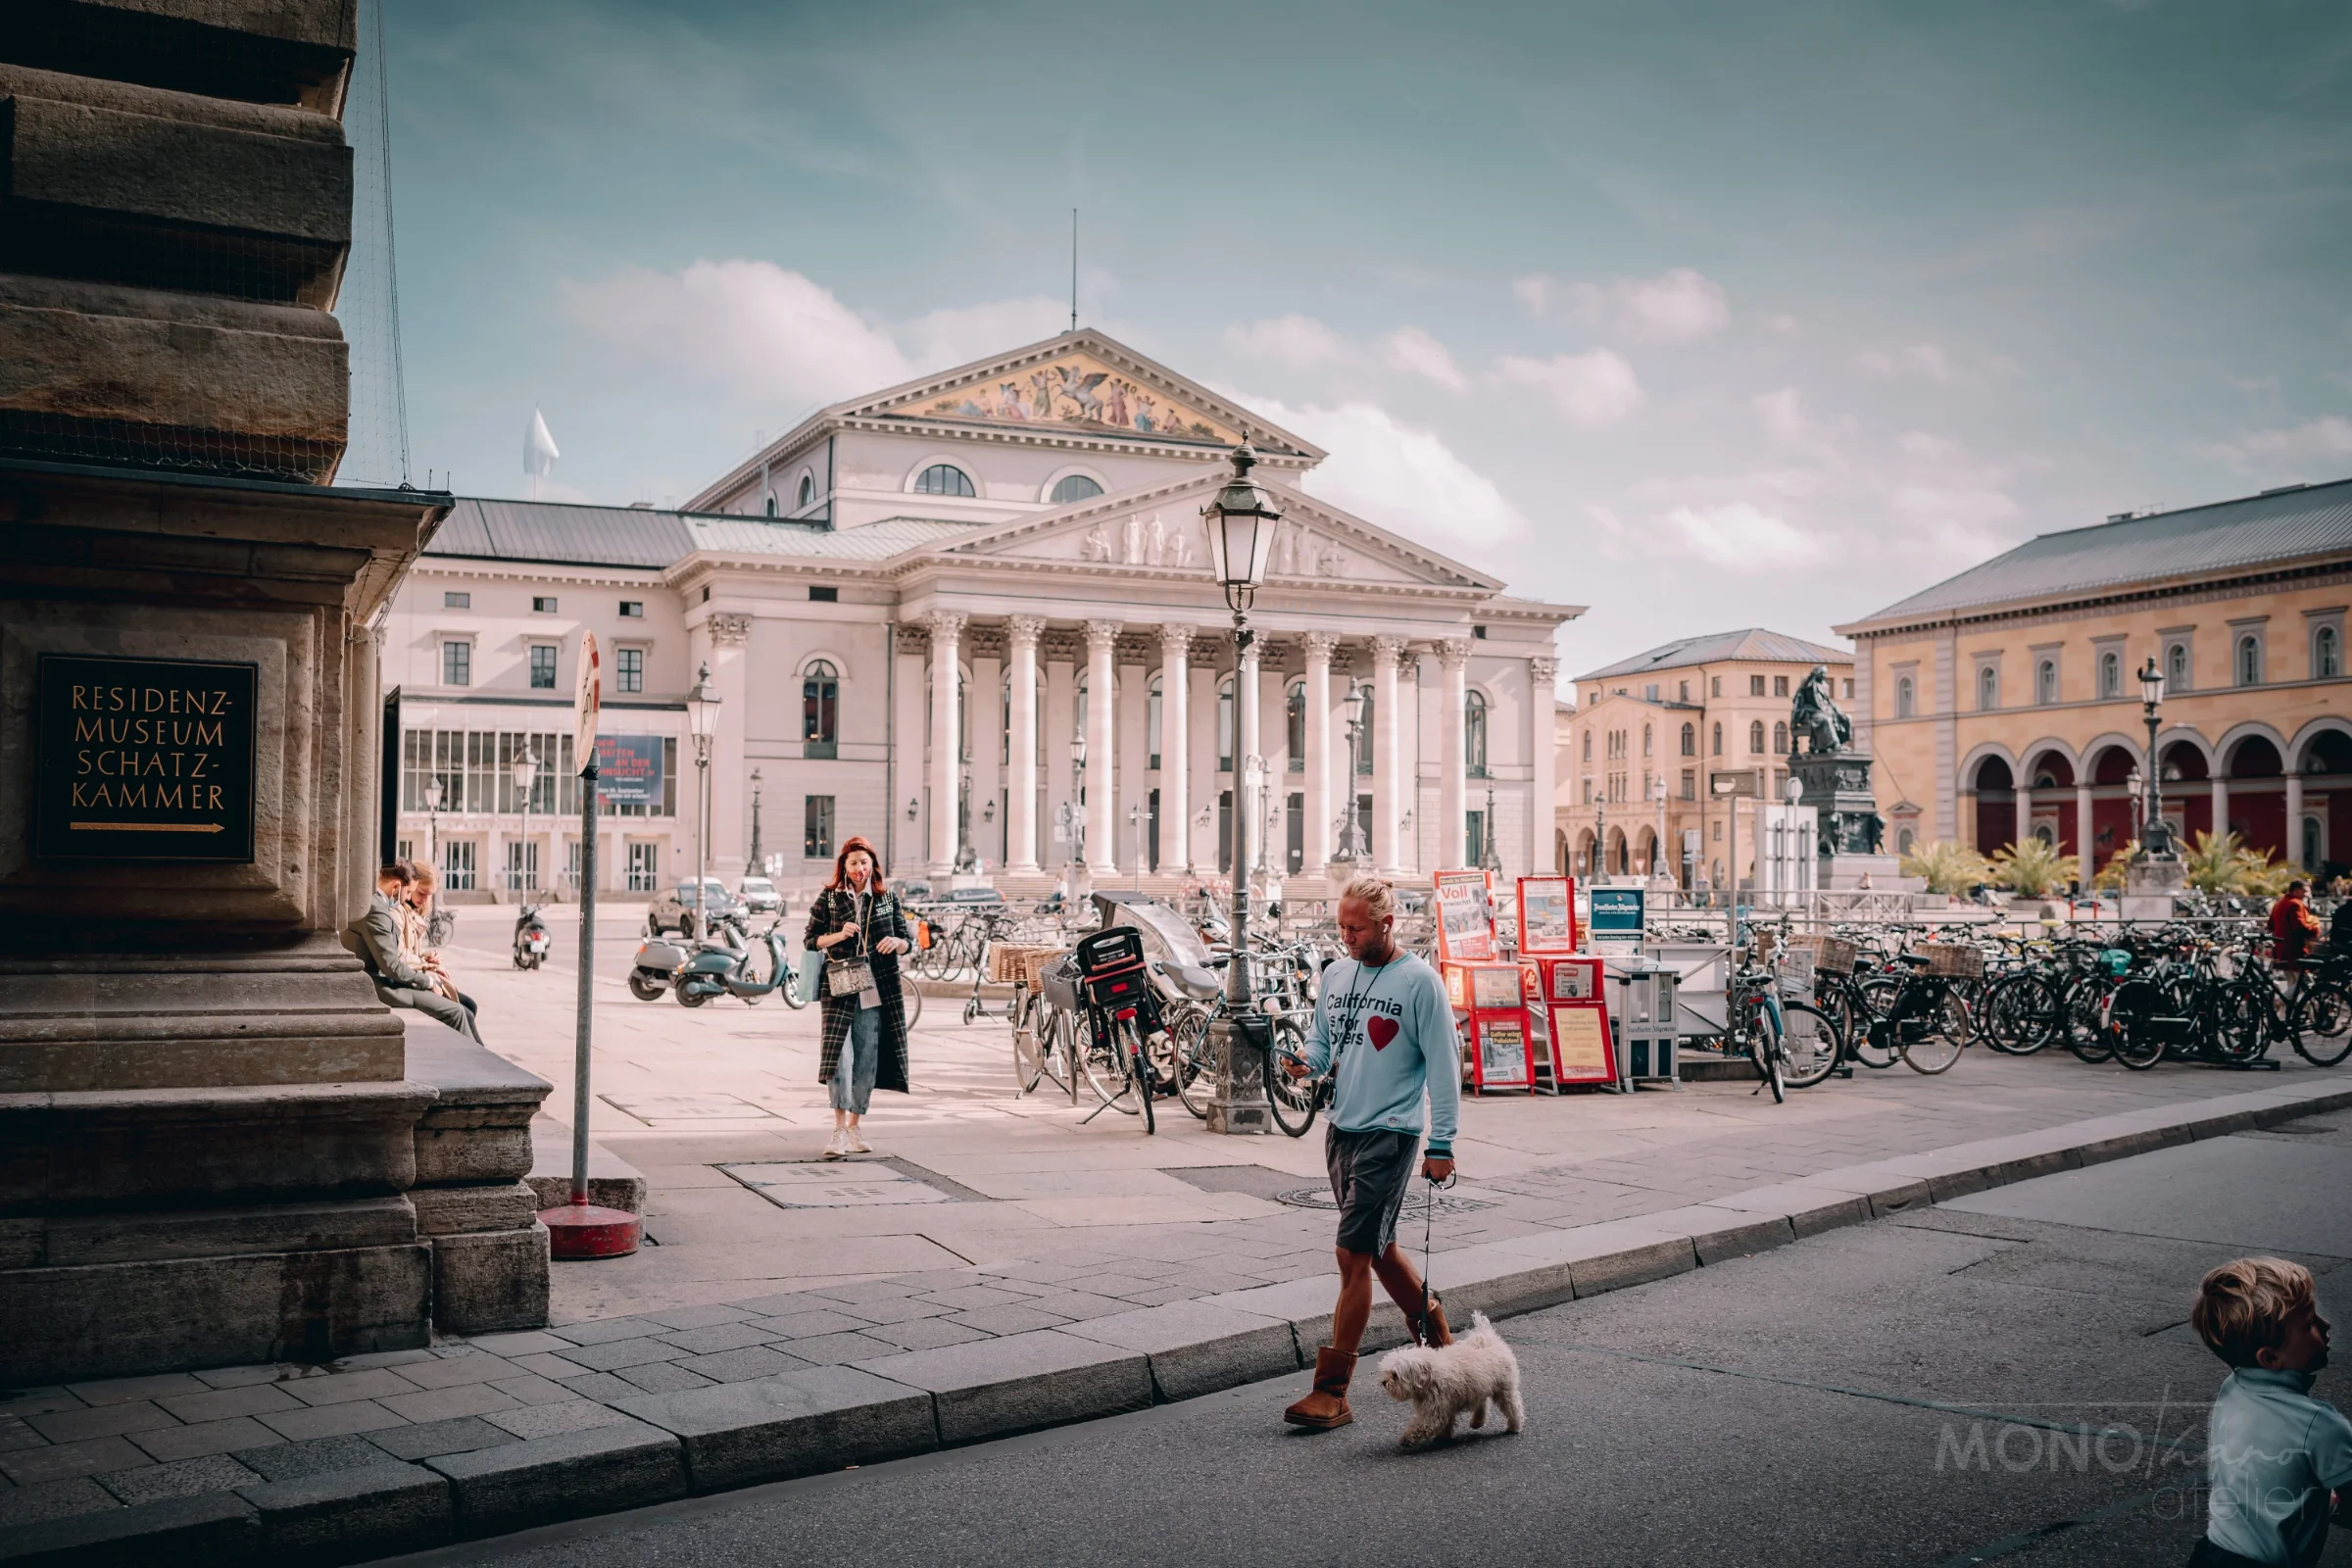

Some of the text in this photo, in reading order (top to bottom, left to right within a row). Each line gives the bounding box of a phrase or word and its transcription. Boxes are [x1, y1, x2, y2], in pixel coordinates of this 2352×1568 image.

[73, 685, 232, 715] RESIDENZ-
[74, 716, 223, 746] MUSEUM
[77, 750, 220, 778] SCHATZ-
[72, 782, 224, 809] KAMMER
[1441, 885, 1467, 900] Voll
[1443, 899, 1471, 907] erwischt!
[1327, 993, 1402, 1016] California
[1338, 1014, 1360, 1031] for
